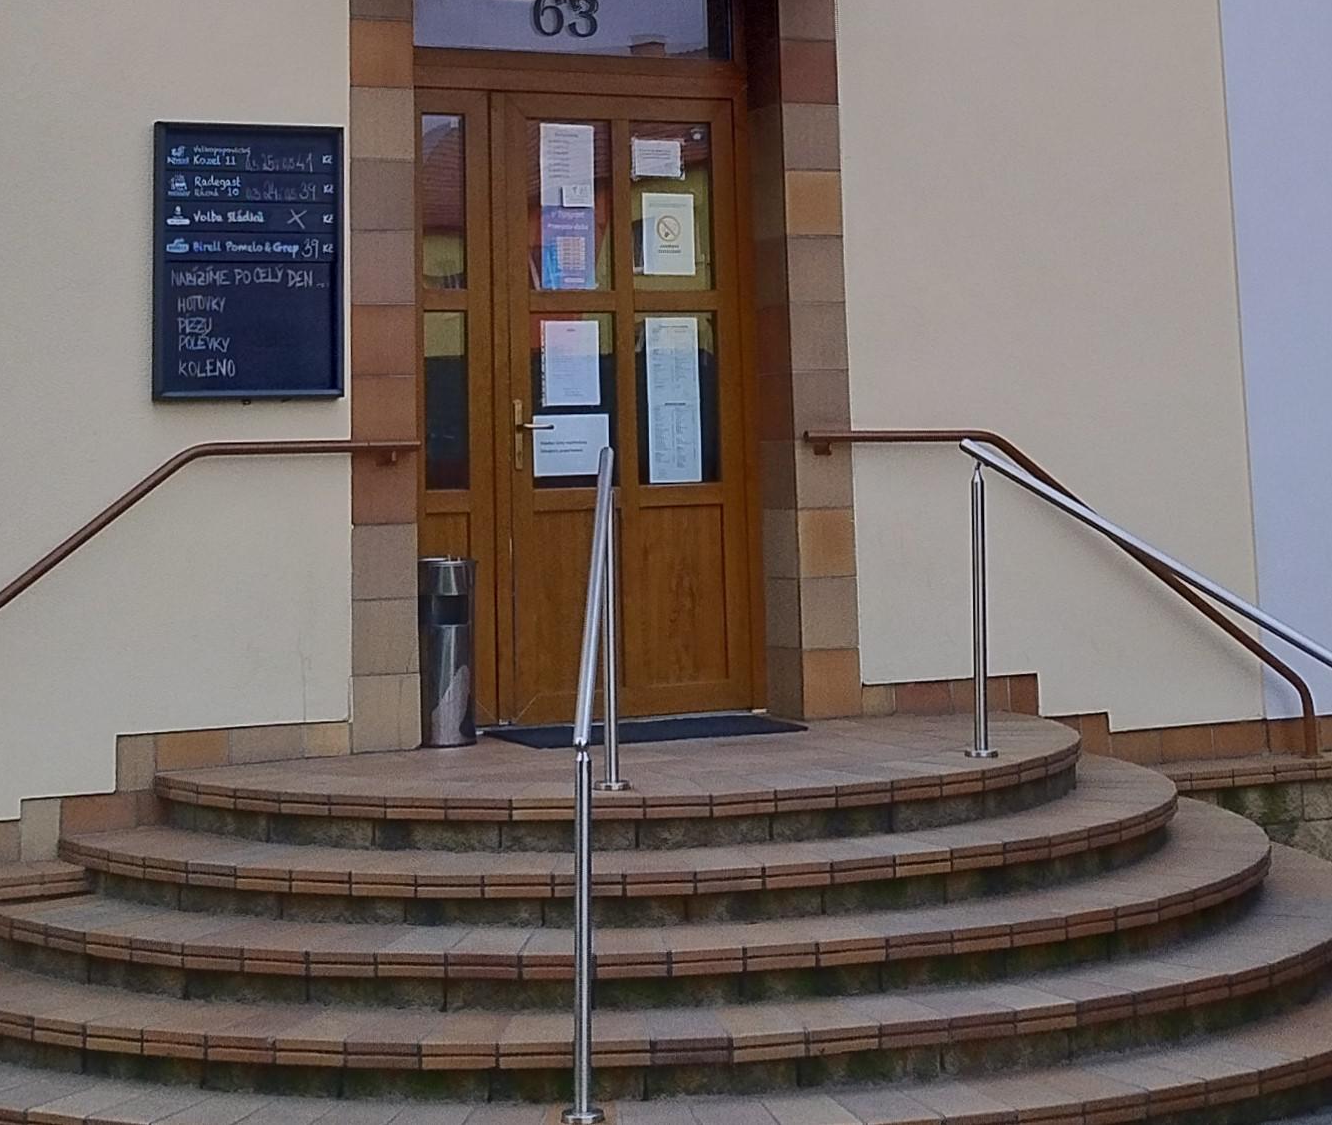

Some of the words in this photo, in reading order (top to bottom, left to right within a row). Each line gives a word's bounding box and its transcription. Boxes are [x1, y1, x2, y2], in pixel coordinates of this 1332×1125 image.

[193, 155, 221, 166] Kozel
[225, 155, 236, 166] 11
[194, 174, 242, 190] Radegast
[227, 187, 240, 197] 10
[193, 209, 224, 223] Volba
[192, 240, 222, 252] Birell
[225, 240, 263, 253] Pomelo
[234, 268, 252, 286] PO
[287, 269, 313, 288] DEN
[177, 294, 227, 313] HOTOVKY
[178, 357, 236, 378] KOLENO
